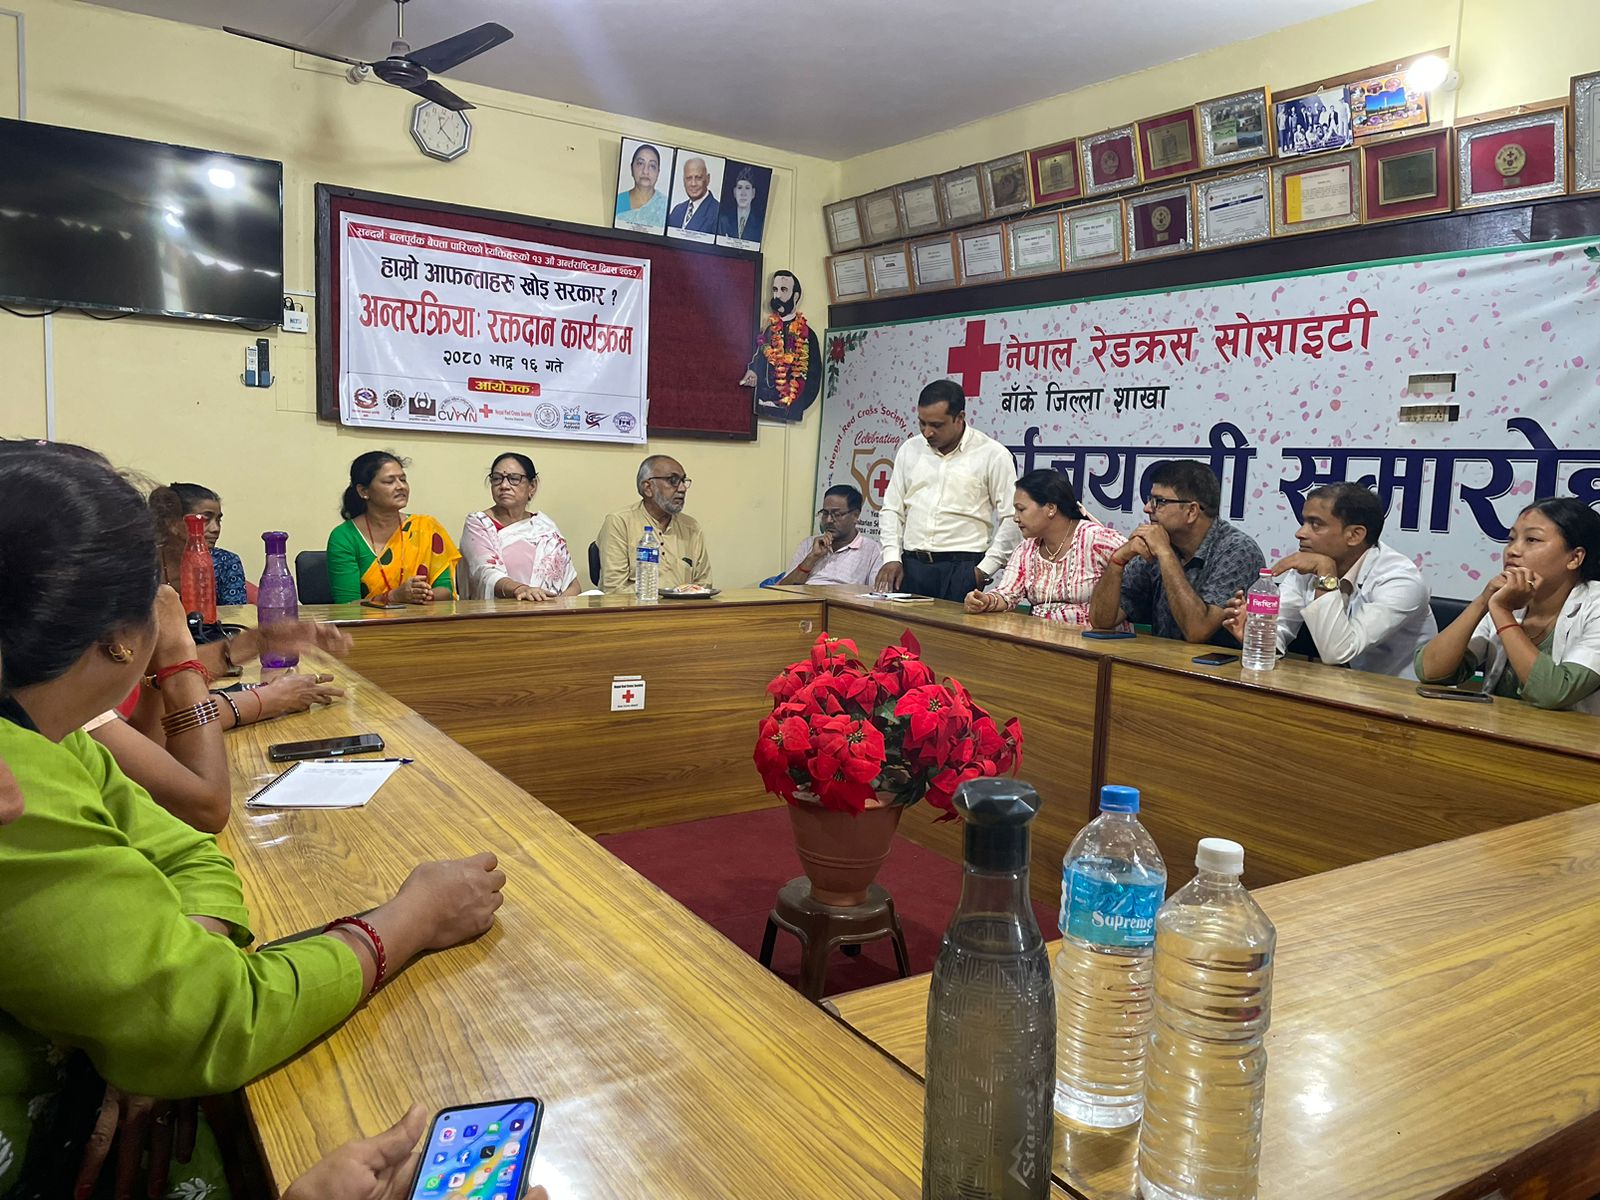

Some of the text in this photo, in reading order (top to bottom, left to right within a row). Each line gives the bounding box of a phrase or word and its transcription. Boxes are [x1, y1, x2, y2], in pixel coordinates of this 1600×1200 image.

[450, 241, 483, 253] पारिएको
[532, 255, 542, 264] १३
[598, 263, 618, 274] दिवस
[619, 267, 638, 277] २०२३
[381, 254, 419, 281] हाम्रो
[520, 272, 549, 300] खोइ
[554, 281, 606, 305] सरकार
[611, 289, 618, 306] ?
[488, 310, 556, 347] रक्तदान
[561, 314, 633, 355] कार्यक्रम
[1006, 297, 1379, 373] नेपाल रेडक्रस सोसाइटी
[443, 350, 564, 373] २०८० भाद्र १६ गते
[1000, 381, 1171, 414] बाँके जिल्ला शाखा
[829, 434, 843, 469] Nepal
[842, 416, 856, 433] Red
[857, 407, 878, 419] Cross
[854, 430, 901, 450] Celebrating
[1091, 910, 1154, 931] Supreme
